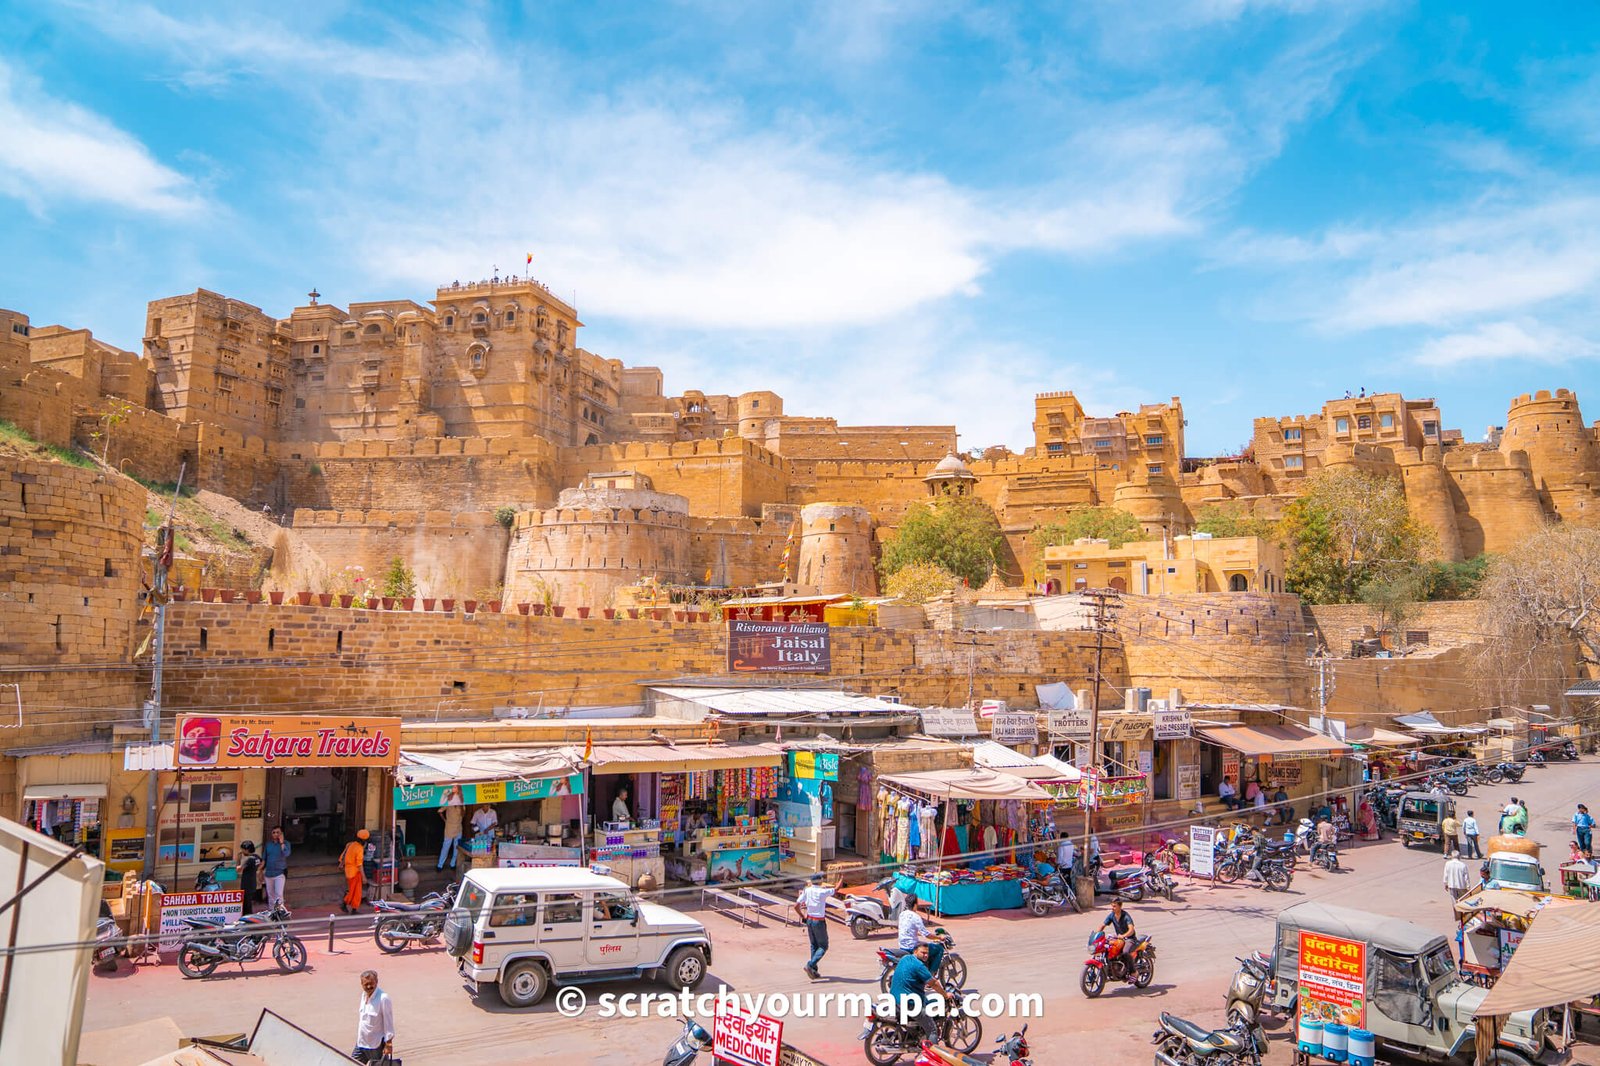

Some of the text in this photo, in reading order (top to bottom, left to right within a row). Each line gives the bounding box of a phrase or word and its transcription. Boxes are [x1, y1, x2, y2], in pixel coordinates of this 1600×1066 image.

[736, 622, 827, 634] Ristorante Italiano
[771, 636, 825, 648] Jaisal
[777, 650, 820, 664] Italy
[994, 728, 1004, 736] RAJ
[1004, 728, 1016, 736] HAIR
[1156, 723, 1189, 732] HAIR DRESSER
[227, 728, 390, 762] Sahara Travels
[1224, 763, 1238, 774] LASSI
[1268, 767, 1300, 778] BHANG SHOP
[514, 780, 543, 792] Bisleri
[402, 786, 434, 802] Bisleri
[164, 892, 242, 906] SAHARA TRAVELS
[180, 908, 206, 916] TOURISTIC
[207, 906, 224, 914] CAMEL
[224, 906, 241, 914] SAFARI
[600, 944, 622, 955] पुलिस
[1305, 936, 1359, 958] चंदन श्री
[716, 1030, 772, 1065] MEDICINE
[790, 1053, 804, 1065] WAY
